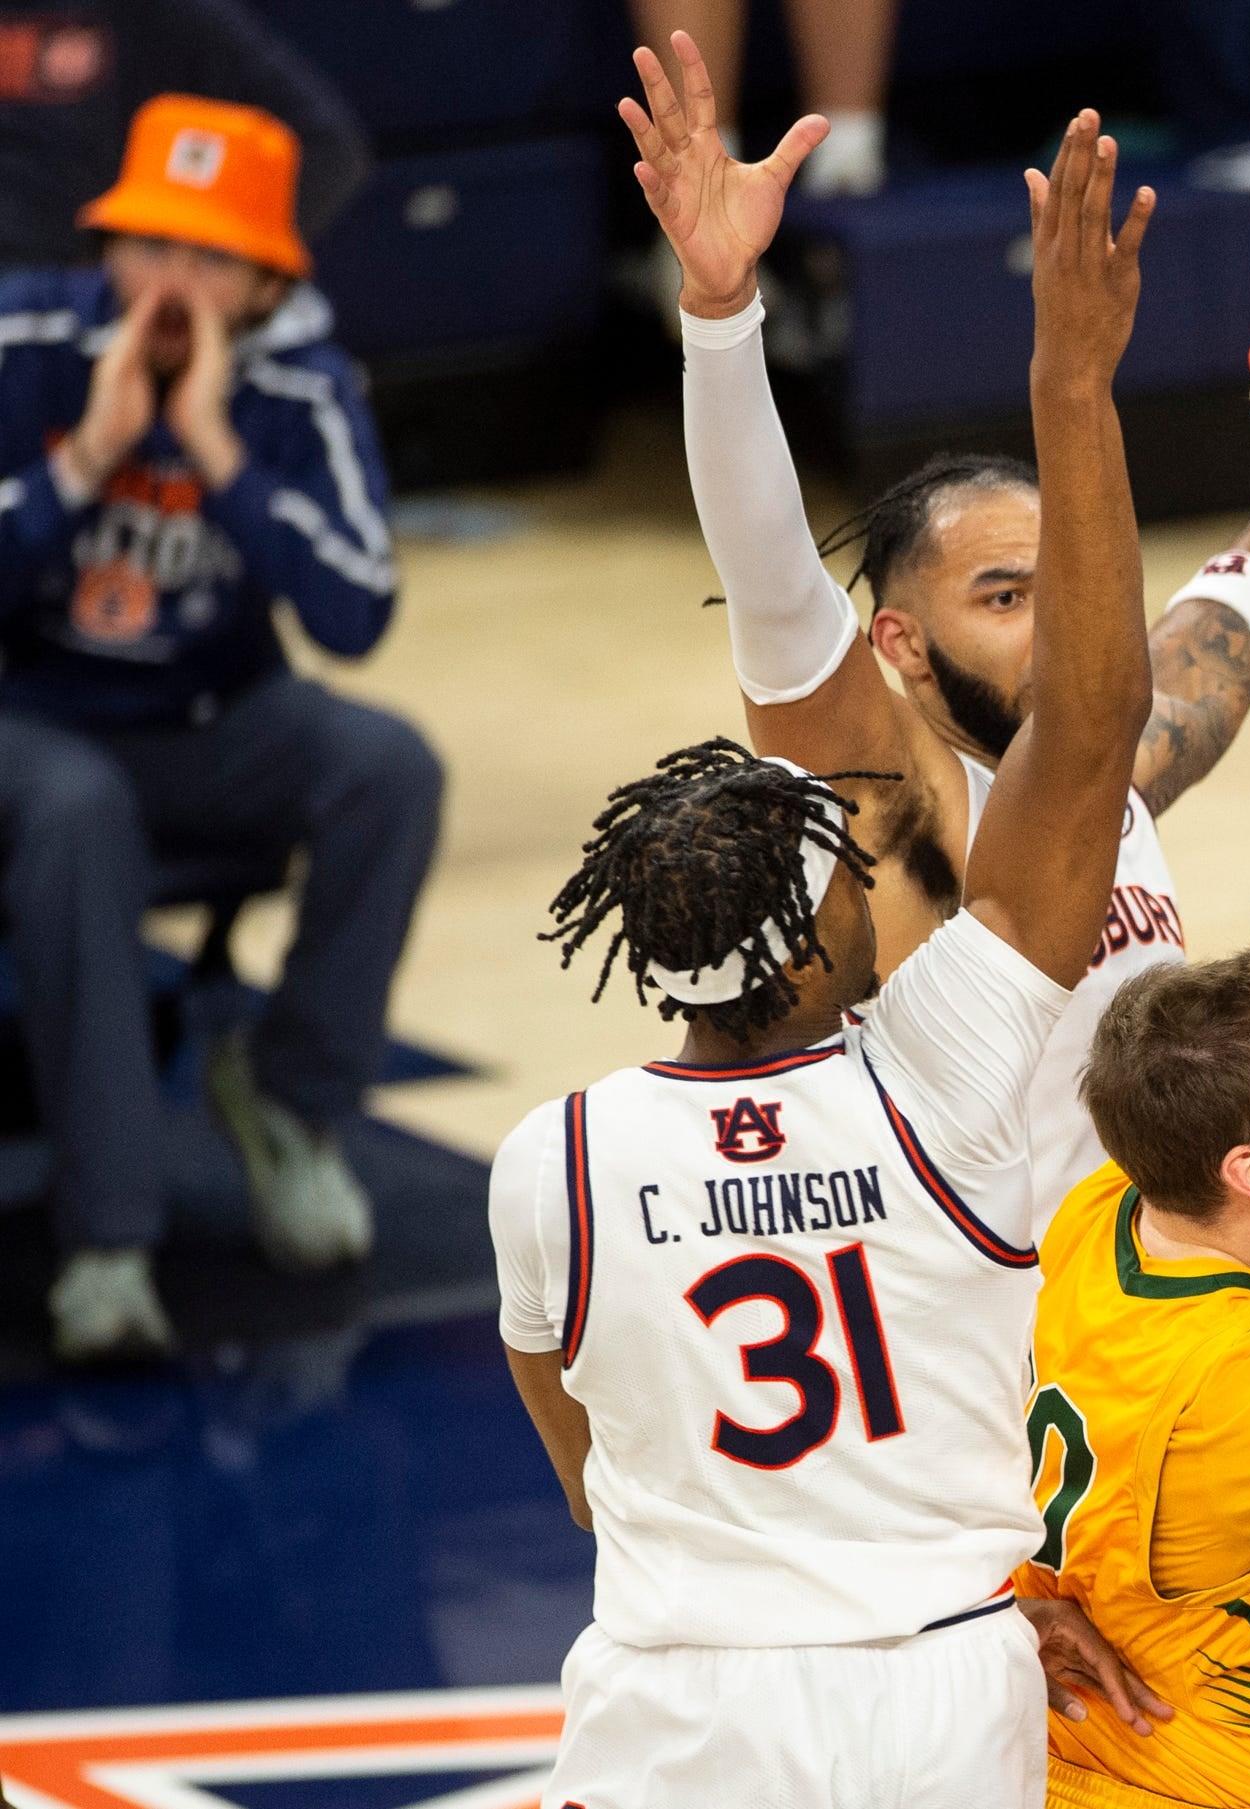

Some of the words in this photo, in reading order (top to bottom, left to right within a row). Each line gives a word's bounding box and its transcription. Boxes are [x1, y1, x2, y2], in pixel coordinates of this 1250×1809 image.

[639, 1184, 681, 1245] C.
[701, 1165, 887, 1237] JOHNSON
[683, 1241, 906, 1471] 31
